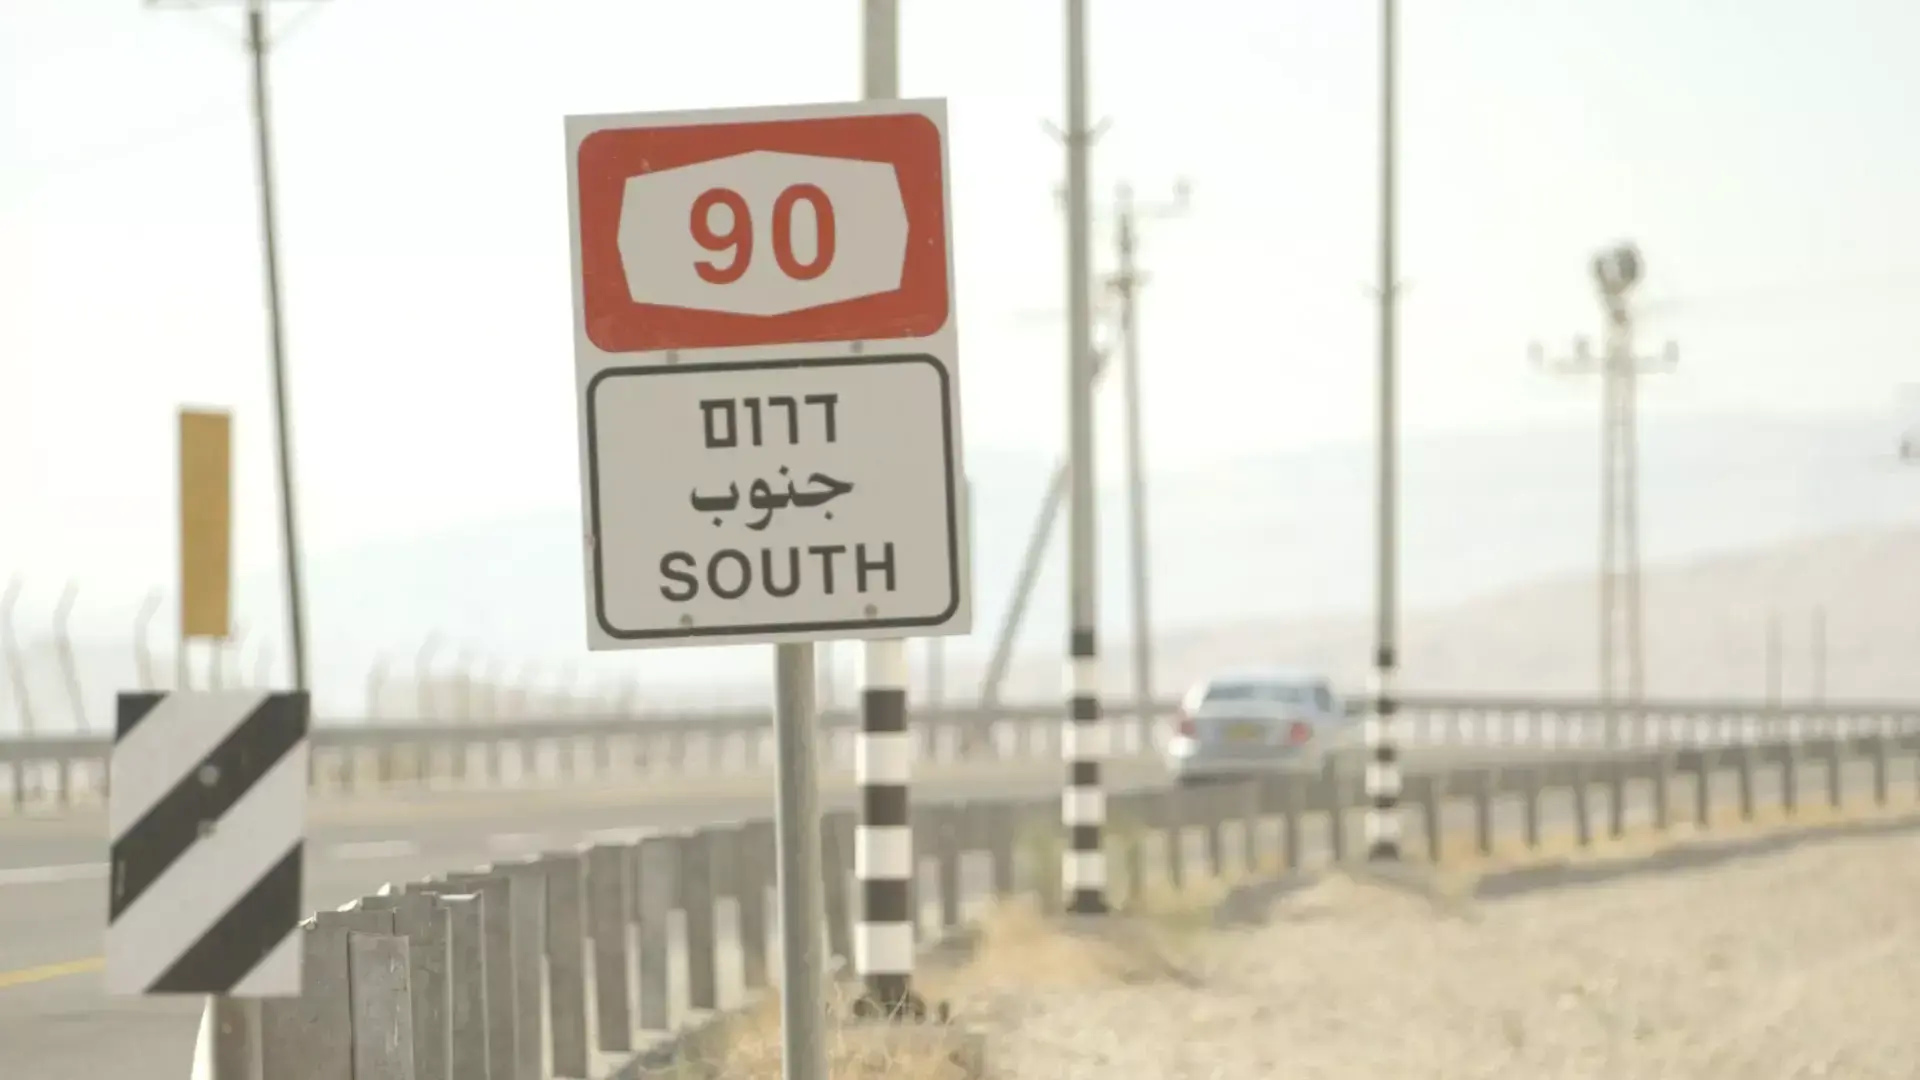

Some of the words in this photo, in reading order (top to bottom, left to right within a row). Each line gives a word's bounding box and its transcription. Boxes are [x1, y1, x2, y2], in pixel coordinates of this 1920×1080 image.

[690, 183, 836, 285] 90
[699, 394, 838, 449] דרום
[690, 465, 854, 532] جنوب
[660, 541, 896, 602] SOUTH
